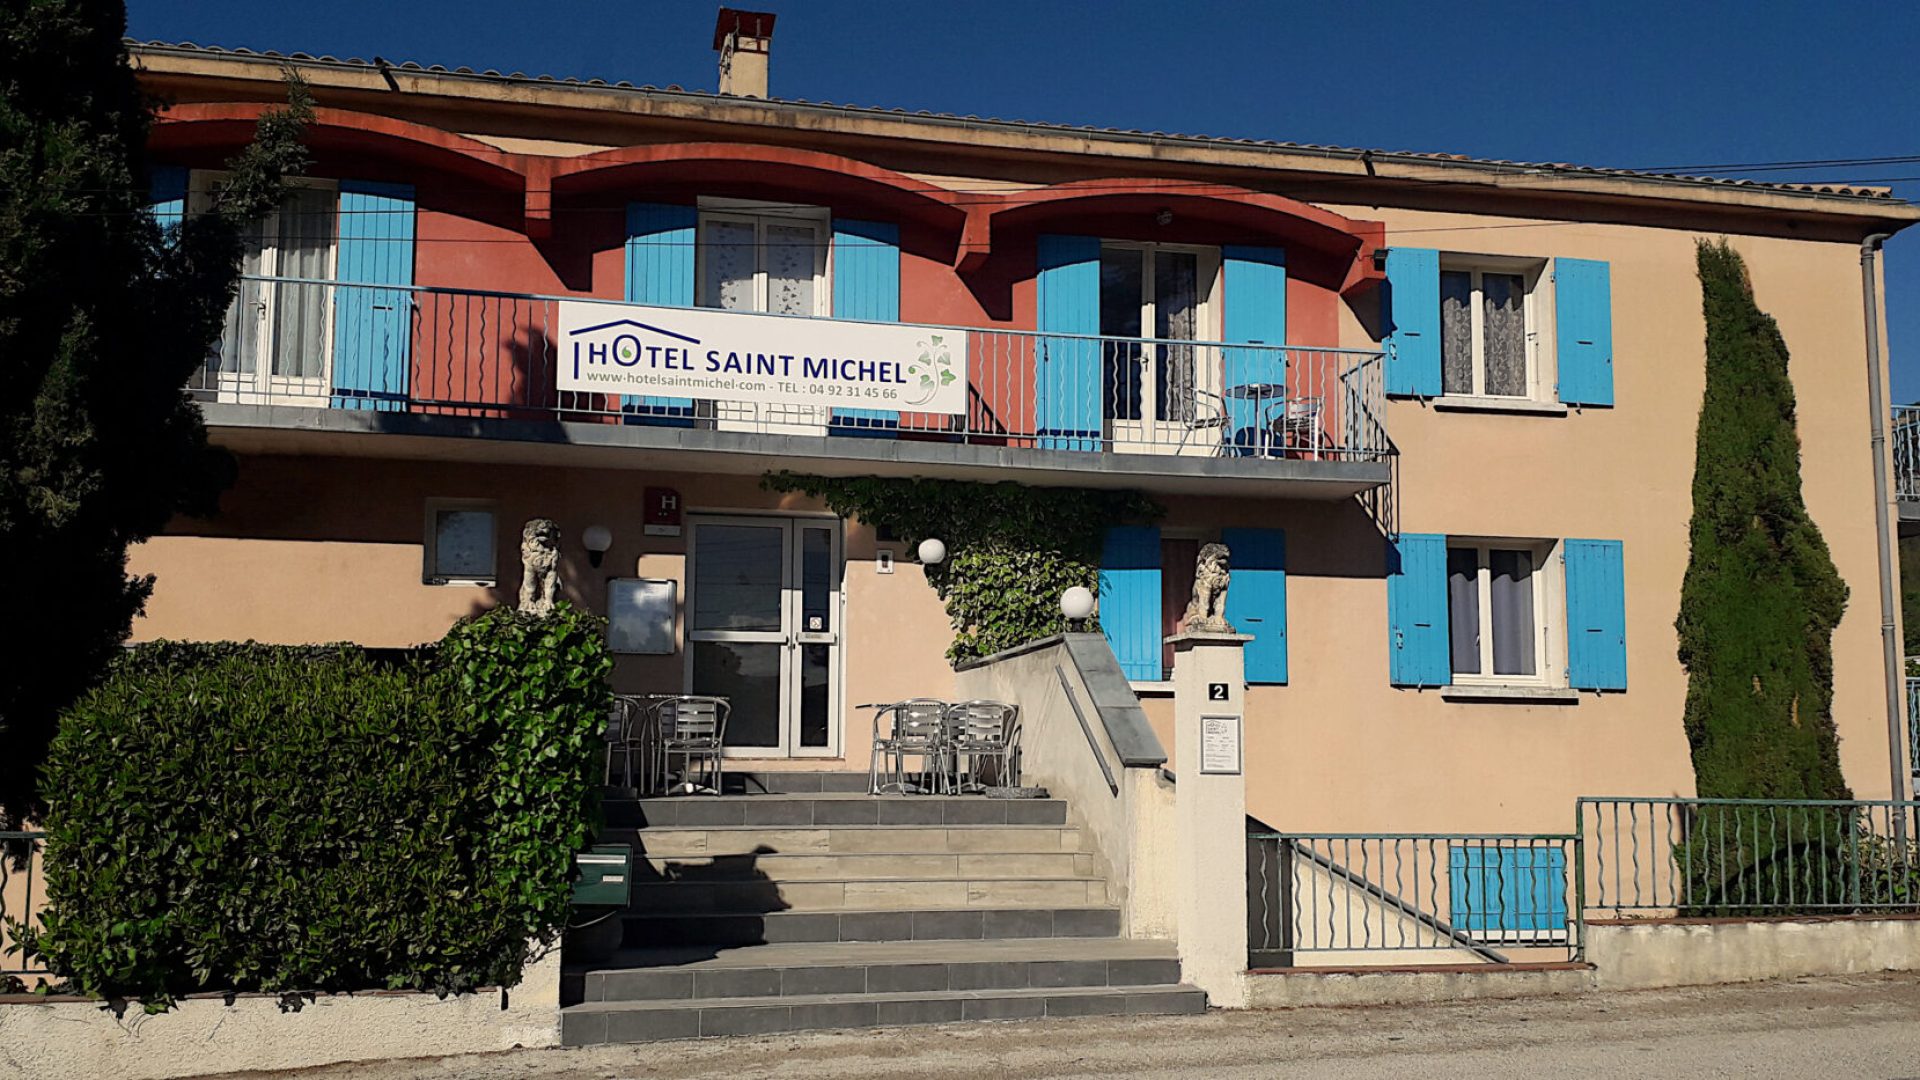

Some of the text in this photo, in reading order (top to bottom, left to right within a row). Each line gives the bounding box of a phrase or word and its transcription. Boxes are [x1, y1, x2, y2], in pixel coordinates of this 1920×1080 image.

[705, 350, 795, 377] SAINT
[803, 356, 907, 384] MICHEL
[777, 381, 799, 394] TEL
[809, 383, 825, 396] 04
[828, 385, 843, 396] 92
[846, 386, 860, 397] 31
[864, 387, 879, 398] 45
[882, 388, 898, 399] 66
[661, 495, 675, 509] H
[1213, 685, 1224, 699] 2
